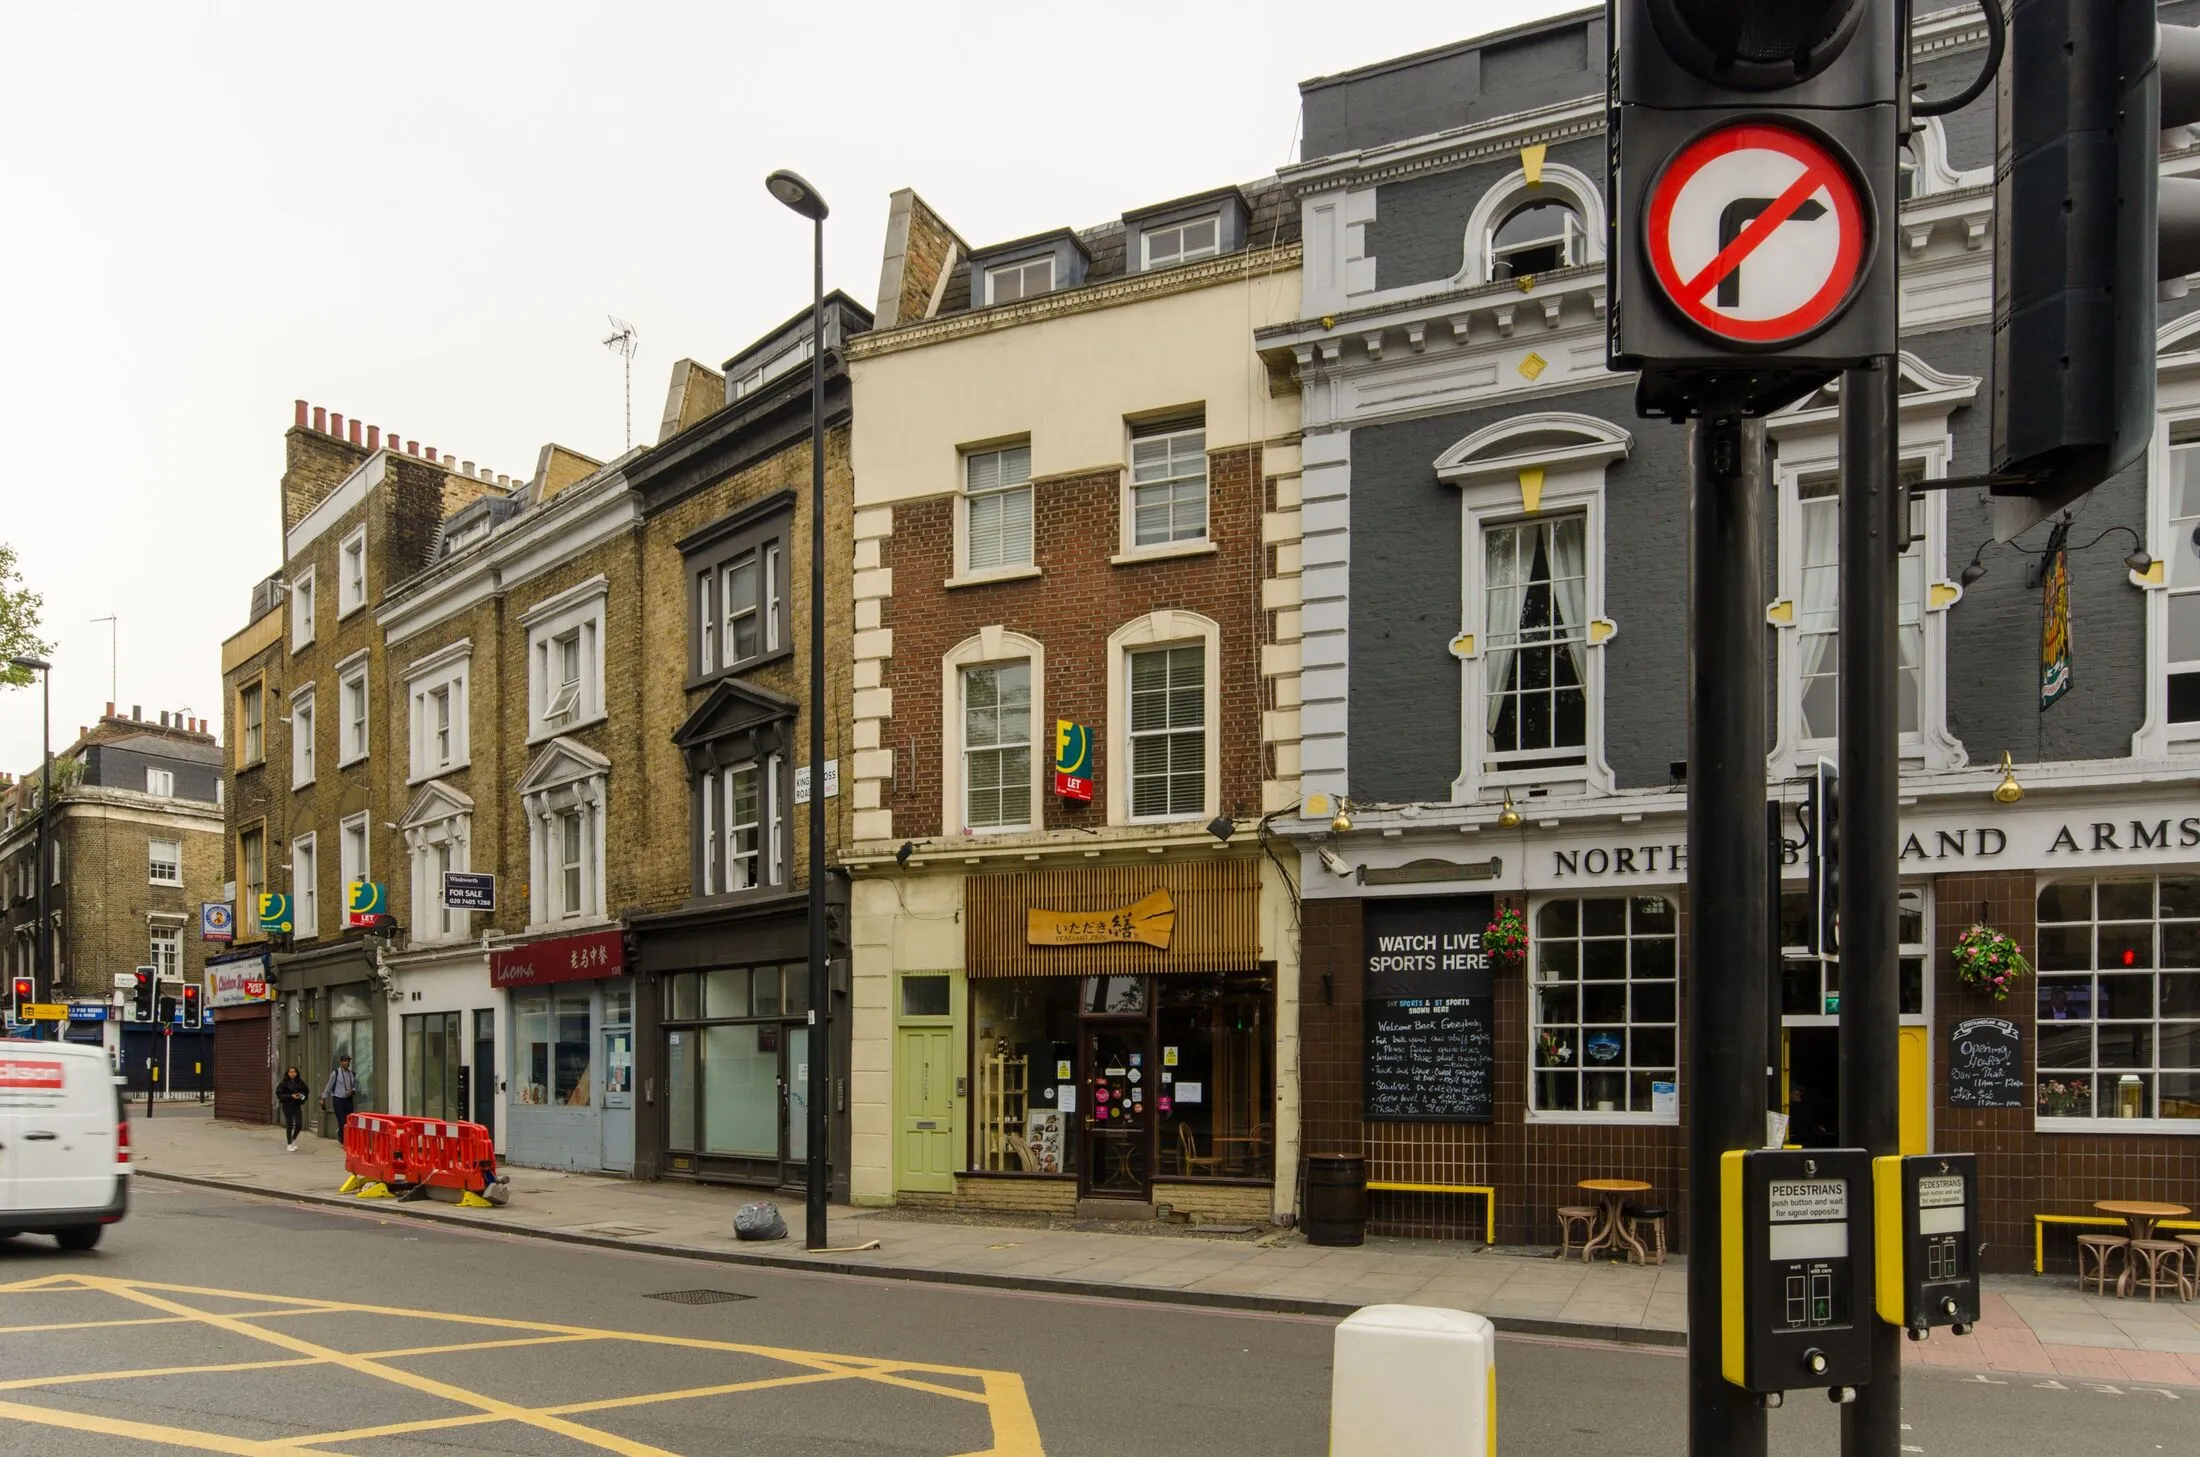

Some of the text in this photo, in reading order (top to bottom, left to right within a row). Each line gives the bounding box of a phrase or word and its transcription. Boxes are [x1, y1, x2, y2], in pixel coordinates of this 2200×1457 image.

[1067, 777, 1081, 789] LET
[796, 788, 812, 799] ROA
[2046, 817, 2200, 853] ARMS
[449, 889, 483, 898] FOR SALE
[1378, 933, 1480, 952] WATCH LIVE
[497, 953, 535, 981] Laoma
[1369, 954, 1489, 972] SPORTS HERE
[1399, 999, 1422, 1007] SPORTS
[1445, 998, 1470, 1006] SPORTS
[1408, 1006, 1430, 1014] SHOWN
[1378, 1020, 1412, 1032] Welcome
[1414, 1021, 1437, 1030] Back
[1961, 1041, 2008, 1061] Opening
[1772, 1184, 1843, 1196] PEDESTRIANS
[1920, 1180, 1961, 1188] PEDESTRIANS
[1771, 1199, 1788, 1208] push
[1775, 1208, 1839, 1218] for signal opposite
